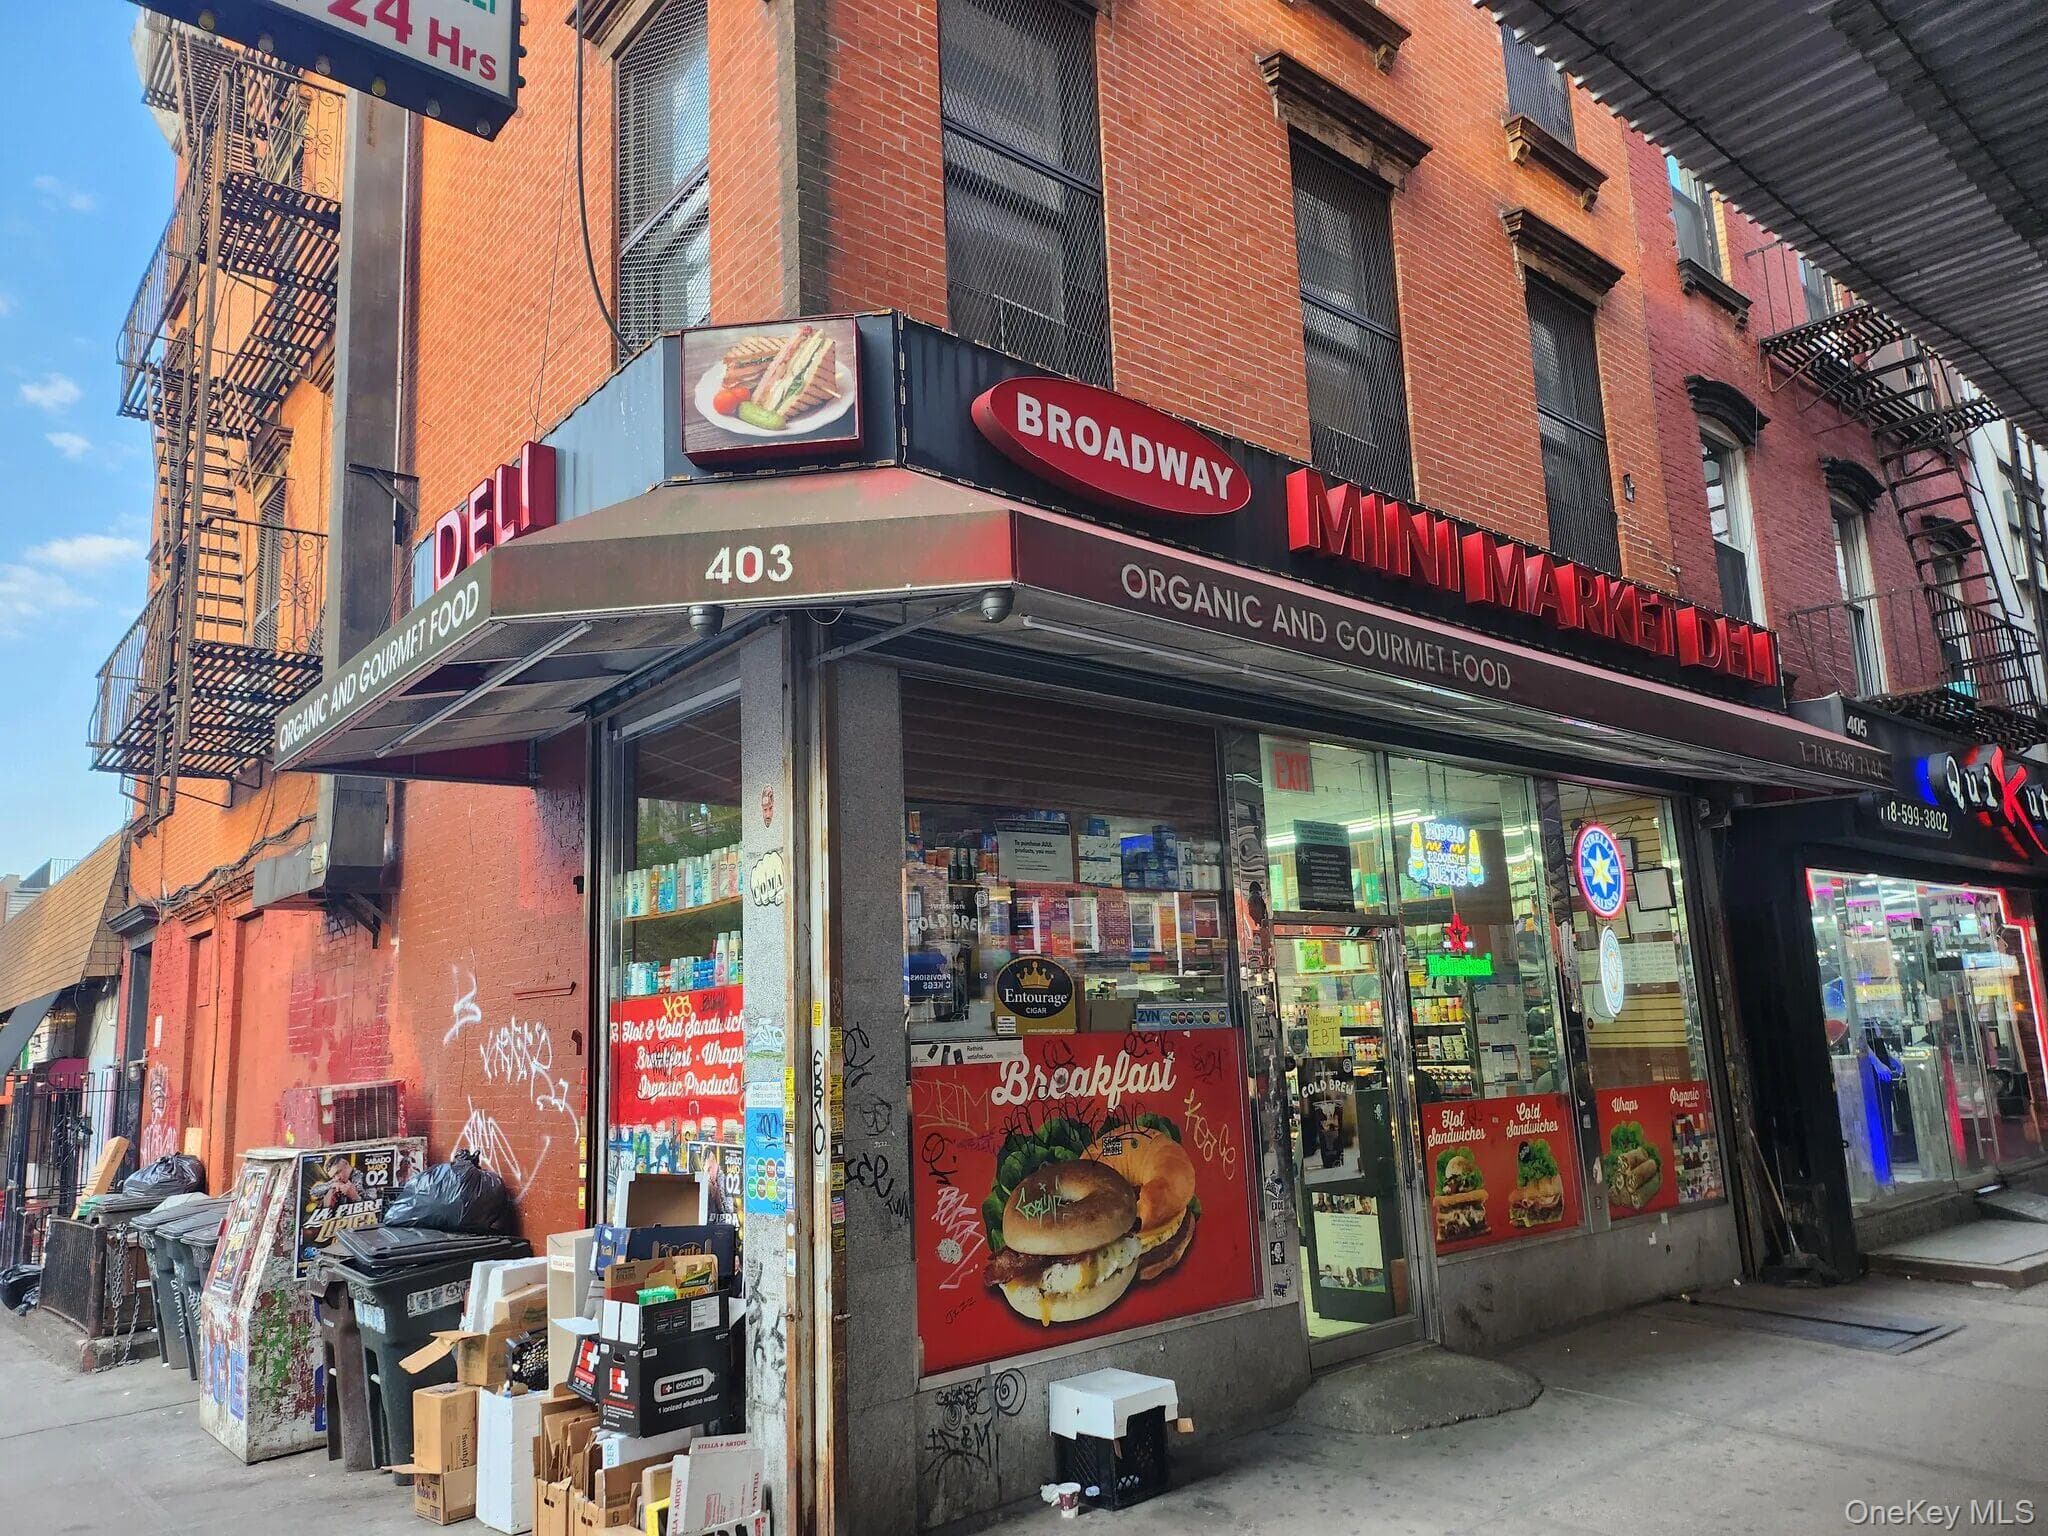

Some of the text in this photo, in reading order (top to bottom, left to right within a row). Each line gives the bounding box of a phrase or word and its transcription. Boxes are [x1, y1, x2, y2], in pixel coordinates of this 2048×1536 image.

[428, 17, 496, 81] Hrs
[1016, 392, 1234, 501] BROADWAY
[434, 441, 556, 591] DELI
[705, 543, 794, 584] 403
[1286, 467, 1777, 687] MINI MARKET DELI
[1121, 564, 1511, 690] ORGANIC AND GOURMET FOOD
[279, 580, 479, 752] ORGANIC AND GOURMET FOOD
[1847, 715, 1867, 738] 405
[1273, 751, 1310, 792] EXIT
[1428, 863, 1468, 887] NETS
[1004, 989, 1067, 1007] Entourage
[1137, 1010, 1160, 1021] ZYN
[622, 1020, 646, 1044] Hot
[656, 1015, 684, 1040] Cold
[1312, 1027, 1337, 1046] EBT
[635, 1040, 744, 1075] Breakfast Wraps
[684, 1072, 738, 1096] Products
[991, 1049, 1178, 1113] Breakfast
[1301, 1079, 1354, 1098] COLD BREW
[1611, 1096, 1638, 1114] Wraps
[1669, 1087, 1699, 1107] Organic
[1441, 1109, 1465, 1130] Hot
[1516, 1102, 1541, 1121] Cold
[1427, 1126, 1486, 1150] Sandwiches
[1506, 1119, 1558, 1141] Sandwiches
[366, 1170, 388, 1186] 02
[726, 1174, 740, 1194] 02
[675, 1376, 702, 1390] essentia
[662, 1402, 682, 1413] ionized
[612, 1511, 620, 1524] 6
